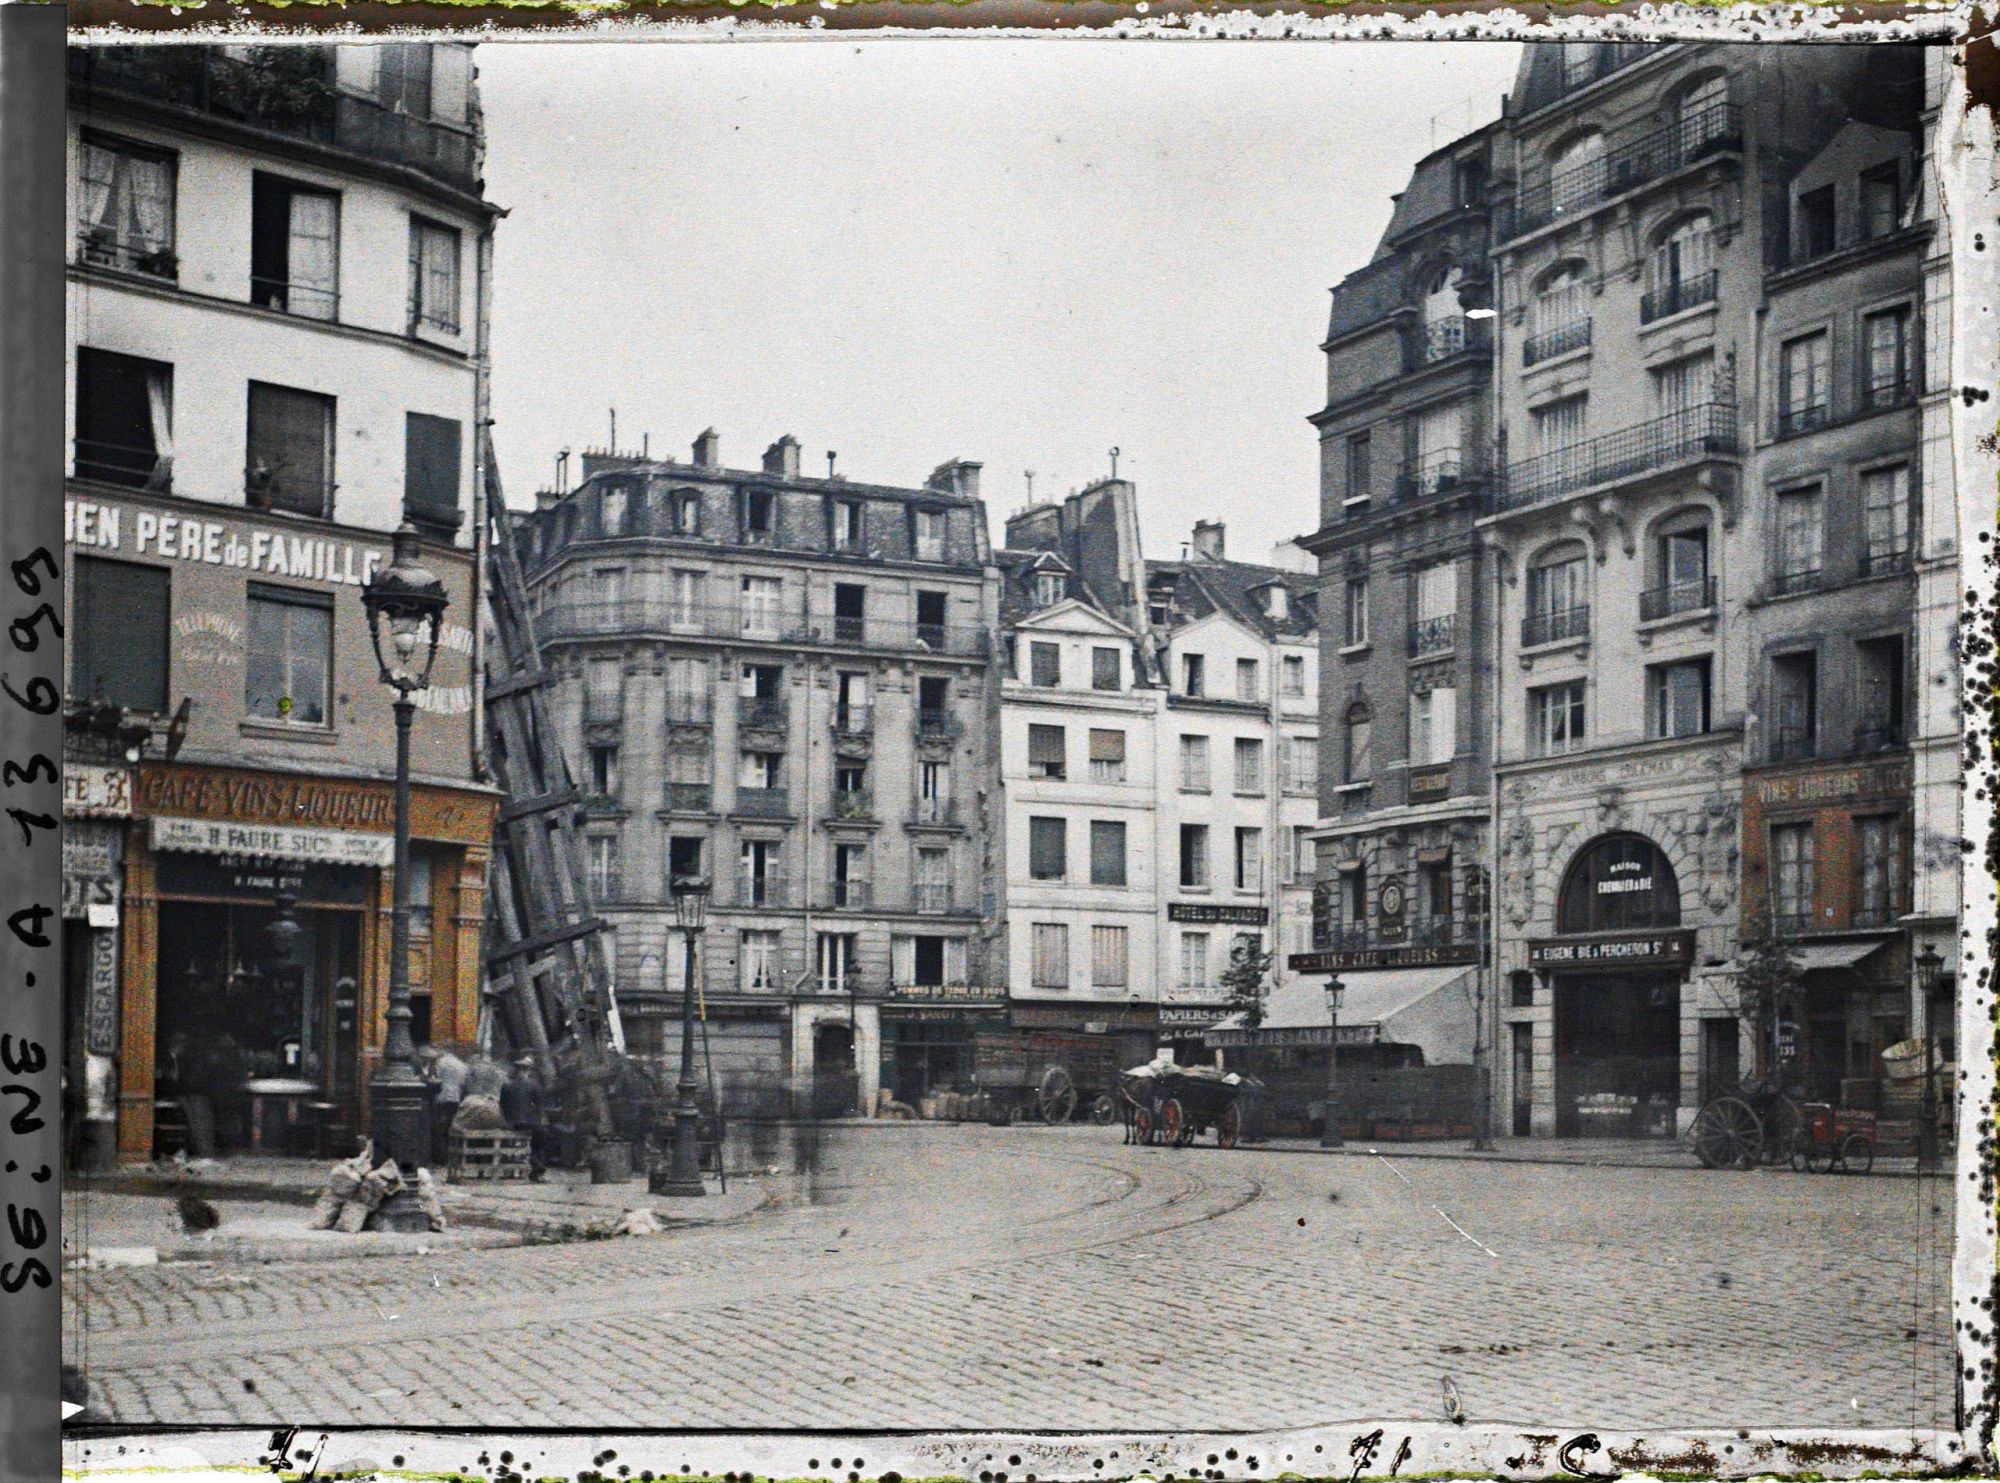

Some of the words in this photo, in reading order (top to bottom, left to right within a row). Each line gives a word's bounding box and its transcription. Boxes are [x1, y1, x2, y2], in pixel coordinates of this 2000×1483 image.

[224, 533, 249, 568] de
[226, 780, 282, 816] VINS
[1758, 779, 1791, 802] VINS
[228, 829, 284, 850] FAURE
[1610, 861, 1641, 873] MAISON
[7, 904, 53, 947] A
[1320, 954, 1344, 967] VINS
[1577, 945, 1592, 959] BIE
[1600, 942, 1650, 957] PERCHERON
[1159, 1009, 1210, 1021] PAPIERS
